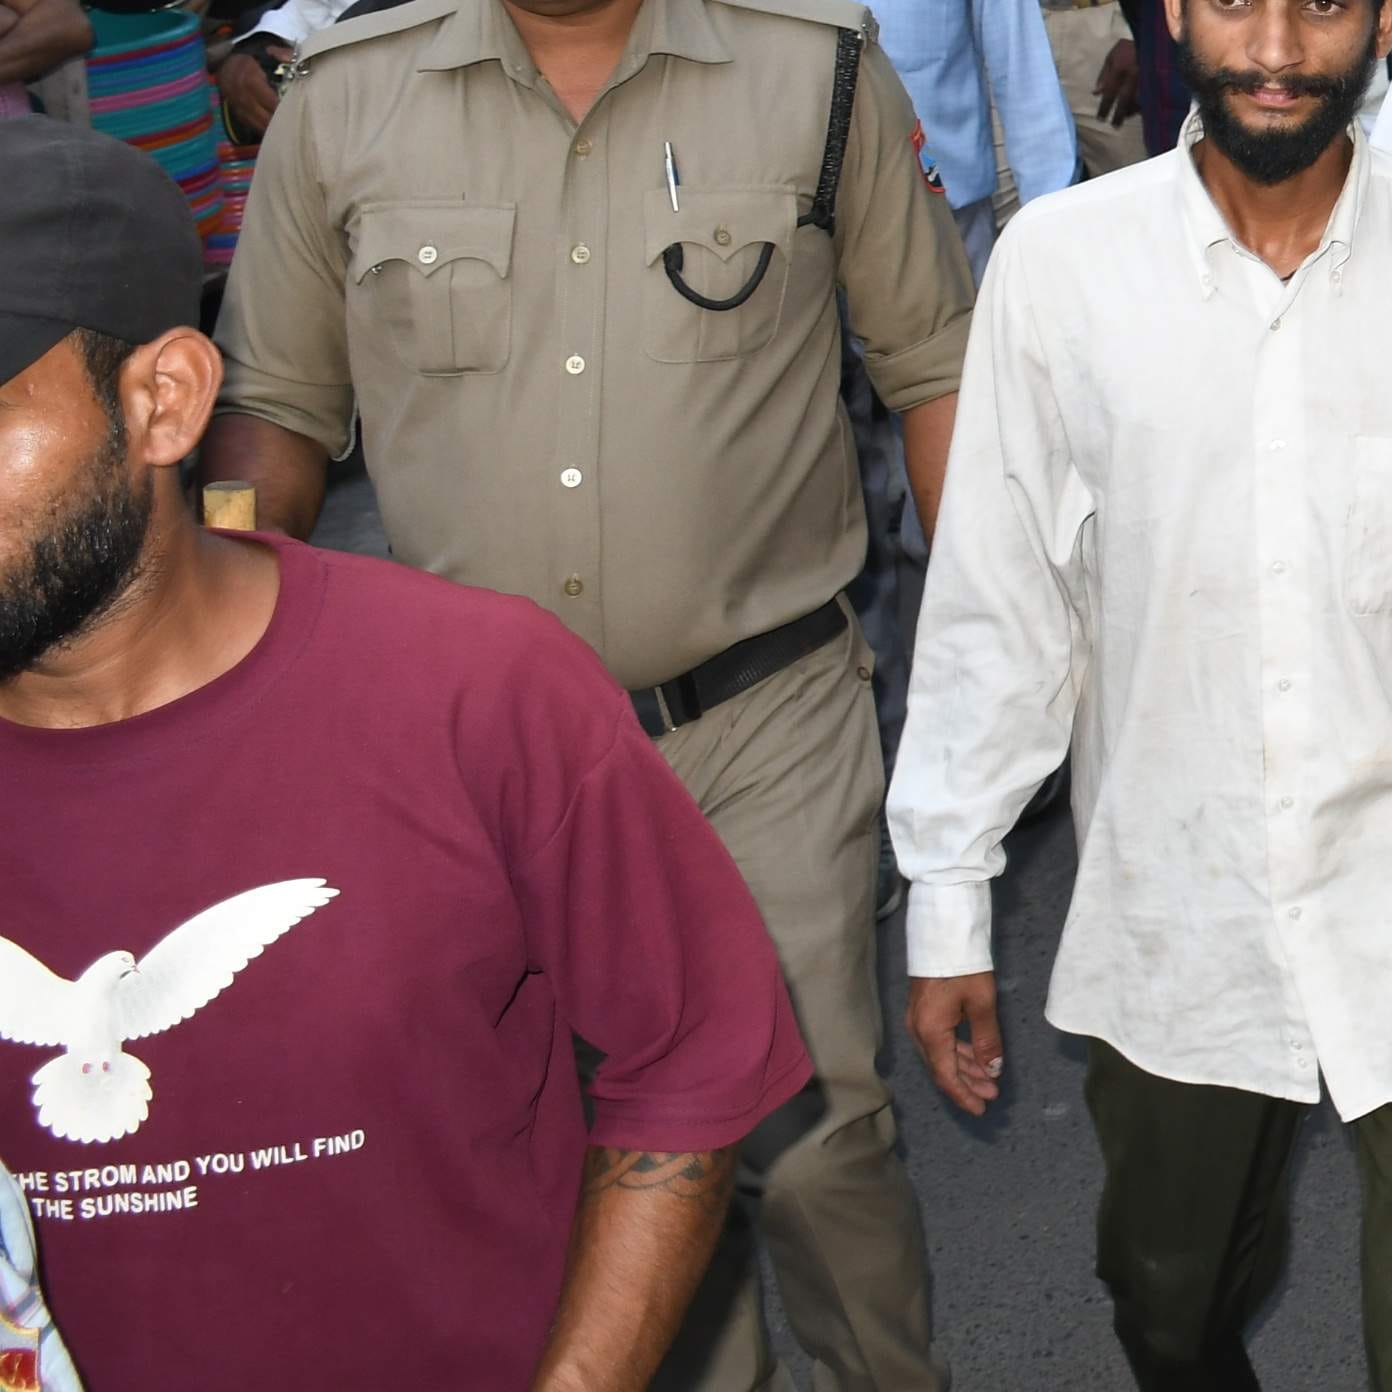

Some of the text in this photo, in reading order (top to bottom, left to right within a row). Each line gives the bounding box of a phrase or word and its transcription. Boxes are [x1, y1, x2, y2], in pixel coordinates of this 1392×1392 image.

[55, 1163, 138, 1194] STROM
[142, 1159, 191, 1185] AND
[194, 1151, 245, 1176] YOU
[251, 1141, 309, 1171] WILL
[313, 1128, 366, 1159] FIND
[32, 1185, 199, 1220] THE SUNSHINE
